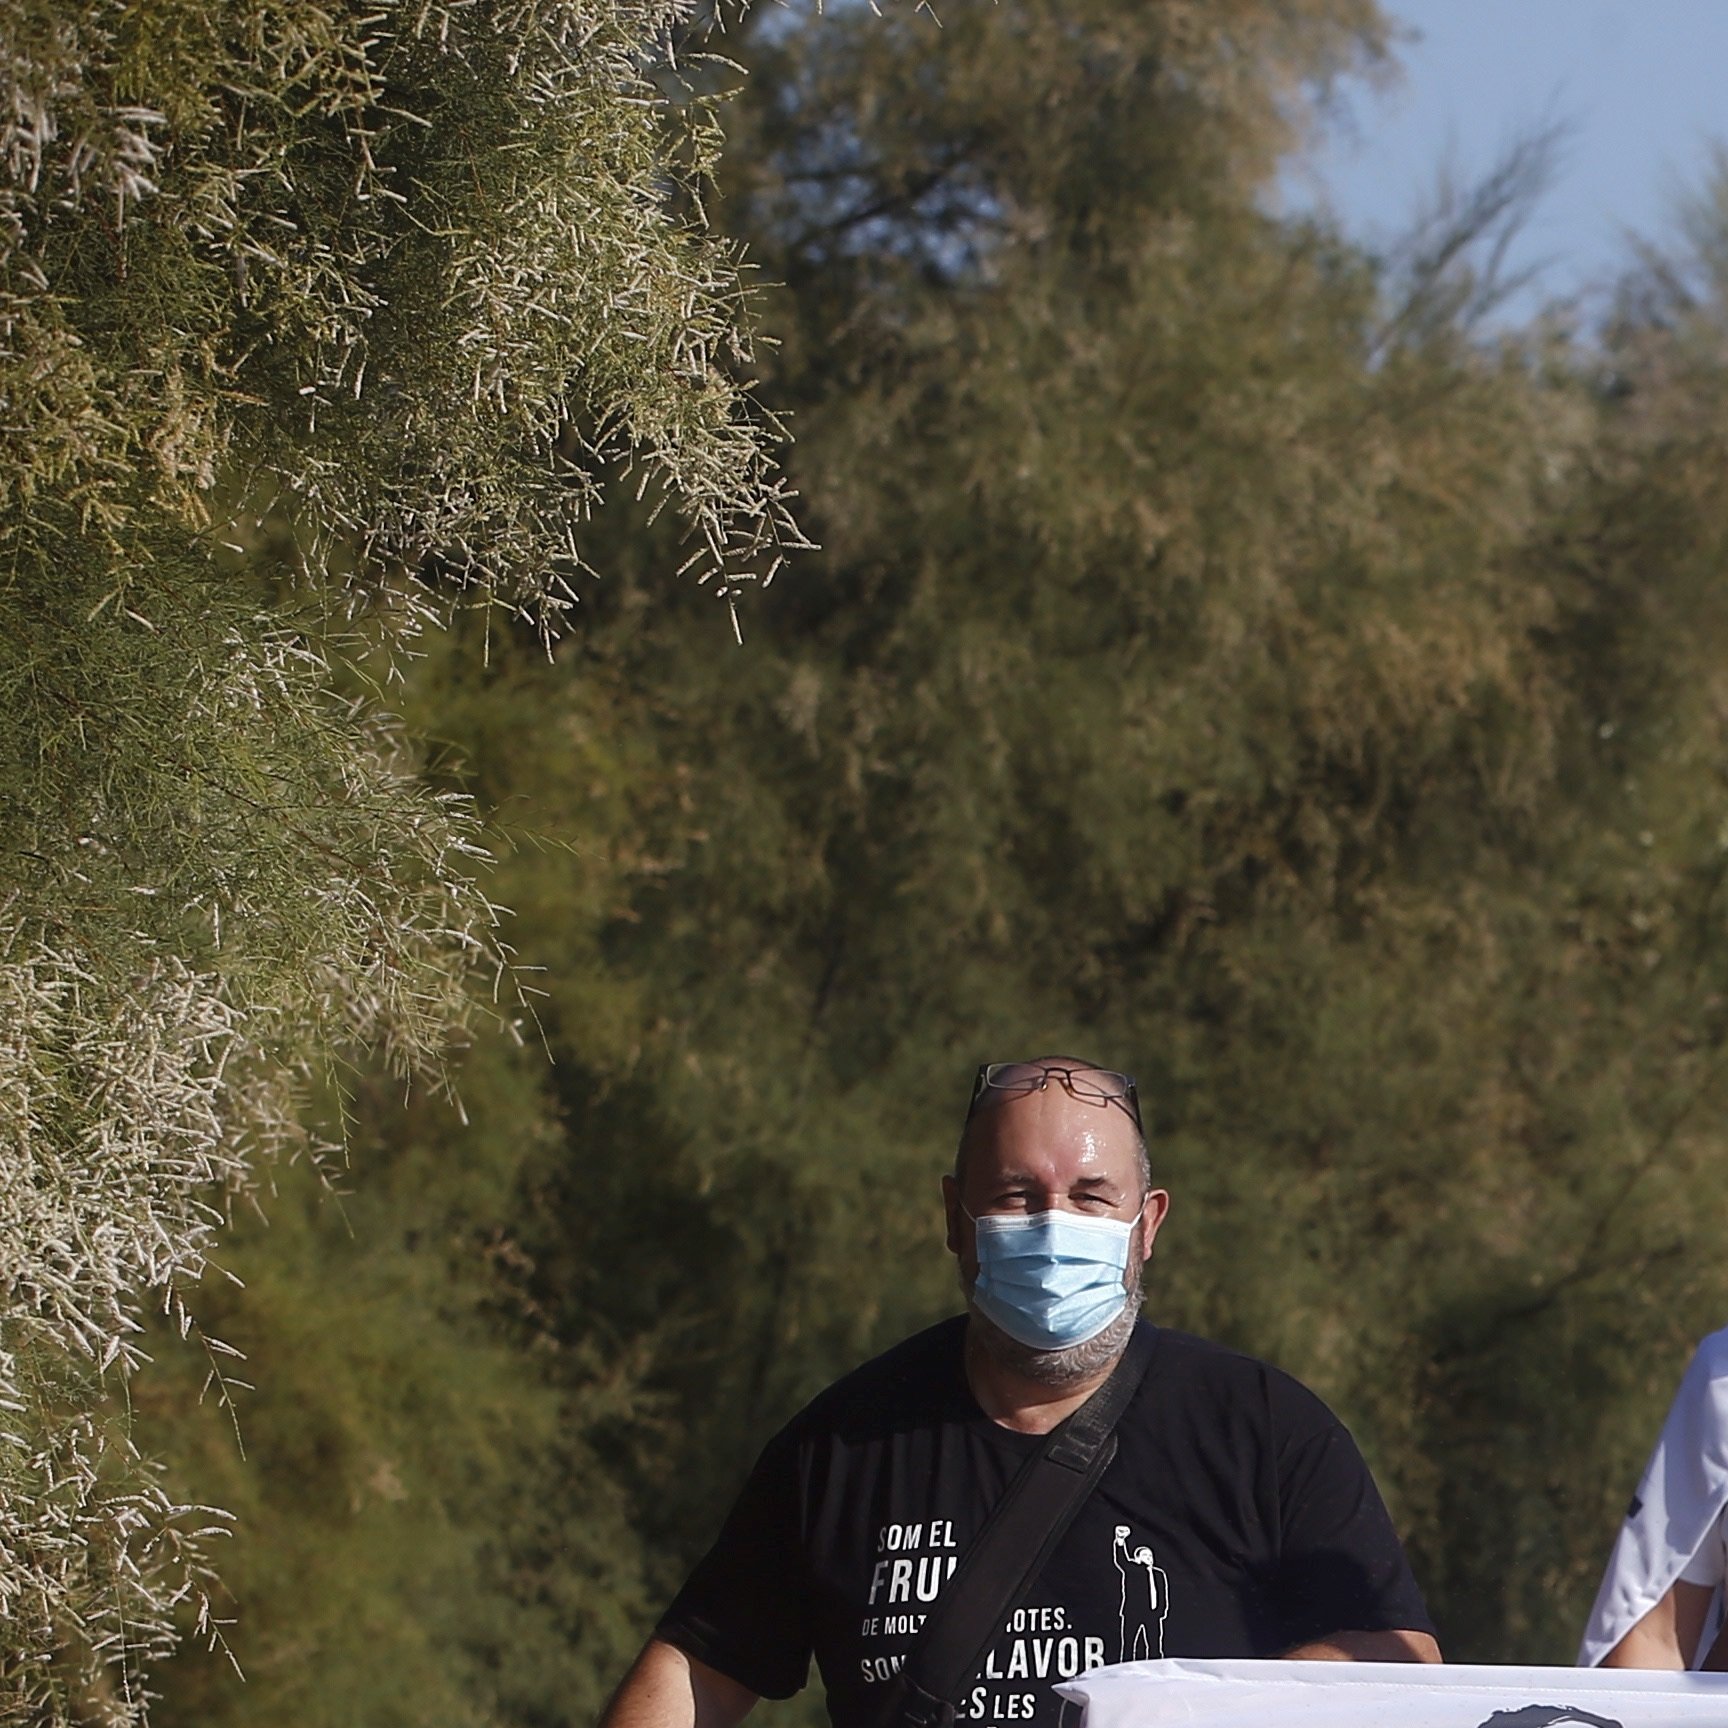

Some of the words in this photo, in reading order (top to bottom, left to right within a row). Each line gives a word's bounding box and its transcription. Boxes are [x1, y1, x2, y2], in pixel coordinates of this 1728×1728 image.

[877, 1523, 923, 1553] SOM
[928, 1520, 957, 1549] EL
[861, 1617, 879, 1636] DE
[1006, 1606, 1073, 1633] OTES.
[976, 1636, 1106, 1680] LAVOR
[992, 1693, 1036, 1719] LES
